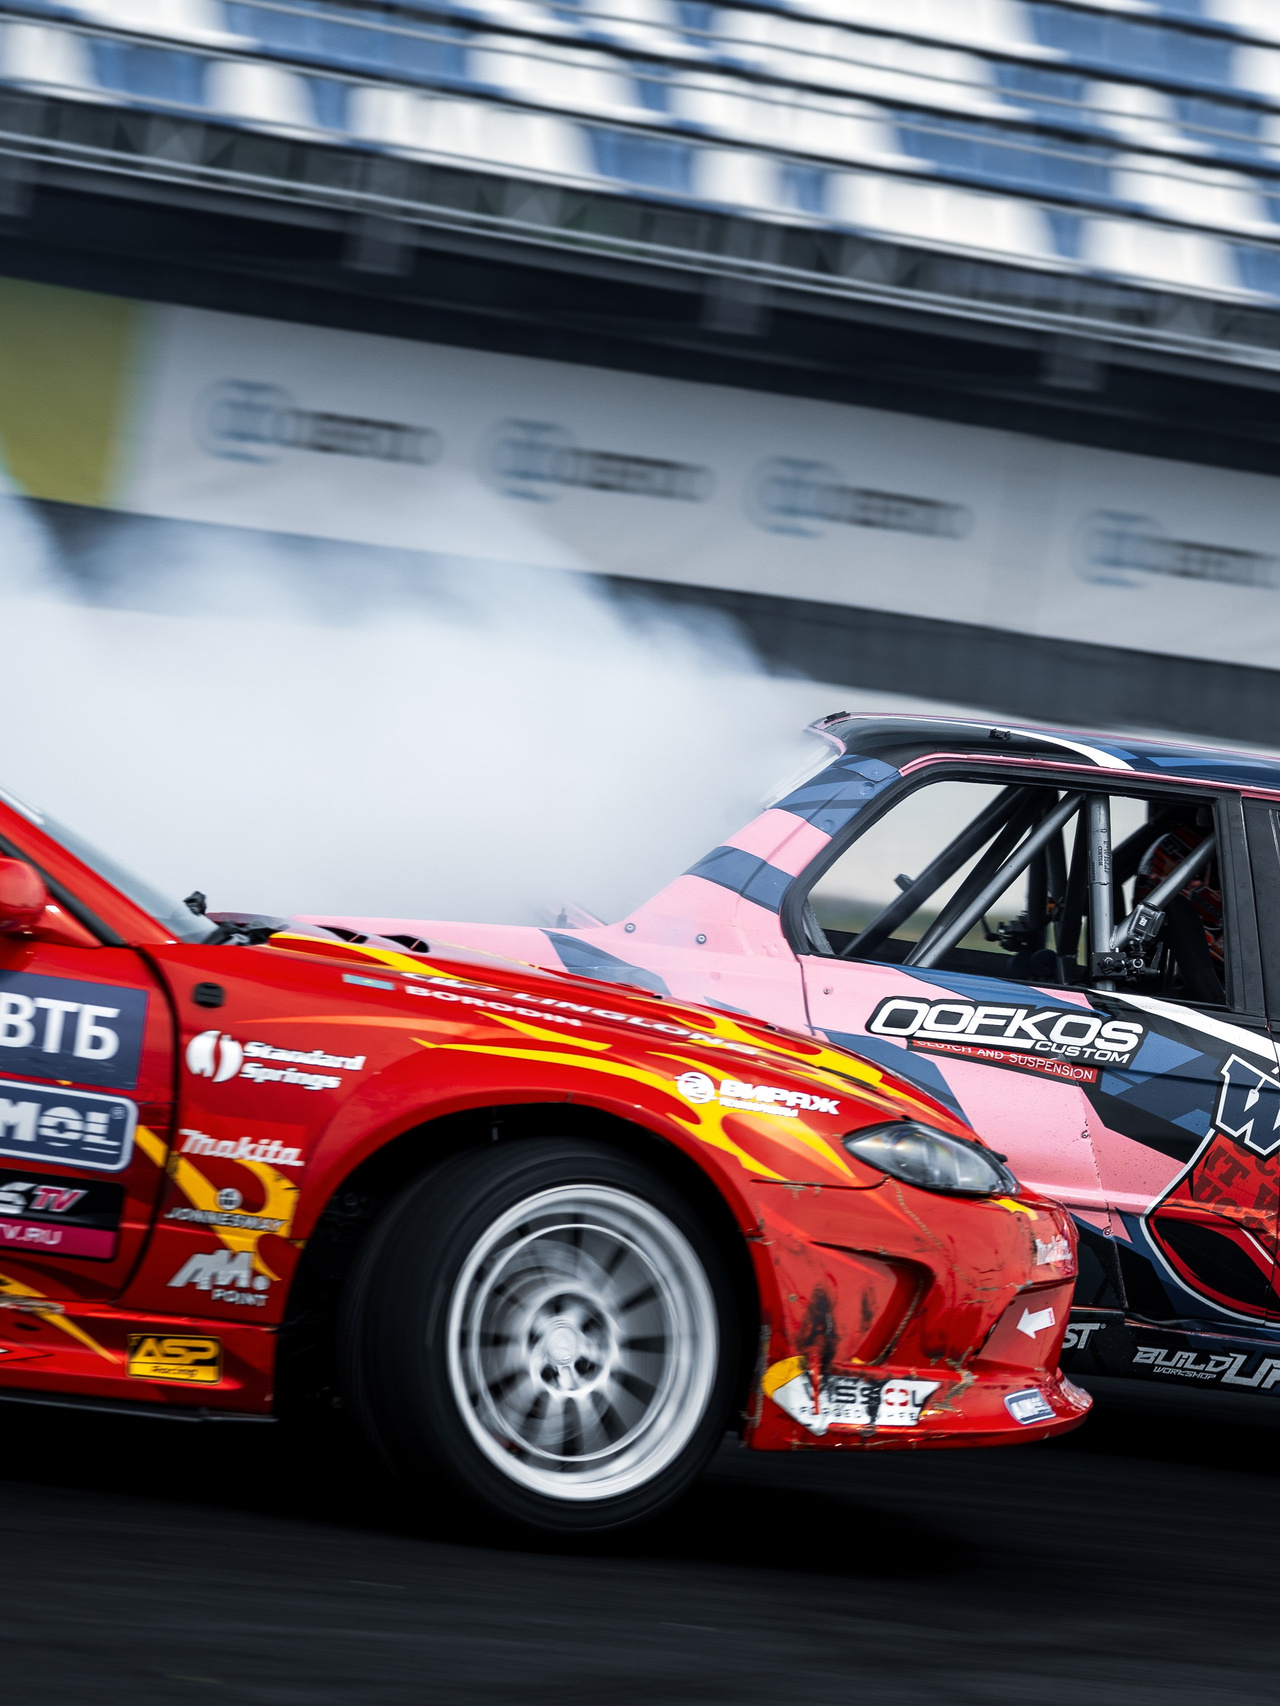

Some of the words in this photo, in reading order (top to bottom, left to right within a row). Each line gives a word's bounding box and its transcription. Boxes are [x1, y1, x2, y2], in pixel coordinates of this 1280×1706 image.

[0, 991, 121, 1060] ВТБ
[512, 992, 758, 1056] LINGLONG
[242, 1041, 367, 1071] Standard
[976, 1048, 1004, 1060] AND
[1008, 1052, 1094, 1080] SUSPENSION
[1034, 1040, 1131, 1064] CUSTOM
[239, 1062, 343, 1091] Springs
[0, 1223, 63, 1245] V.RU
[129, 1337, 221, 1365] ASP
[1152, 1365, 1218, 1381] WORKSHOP
